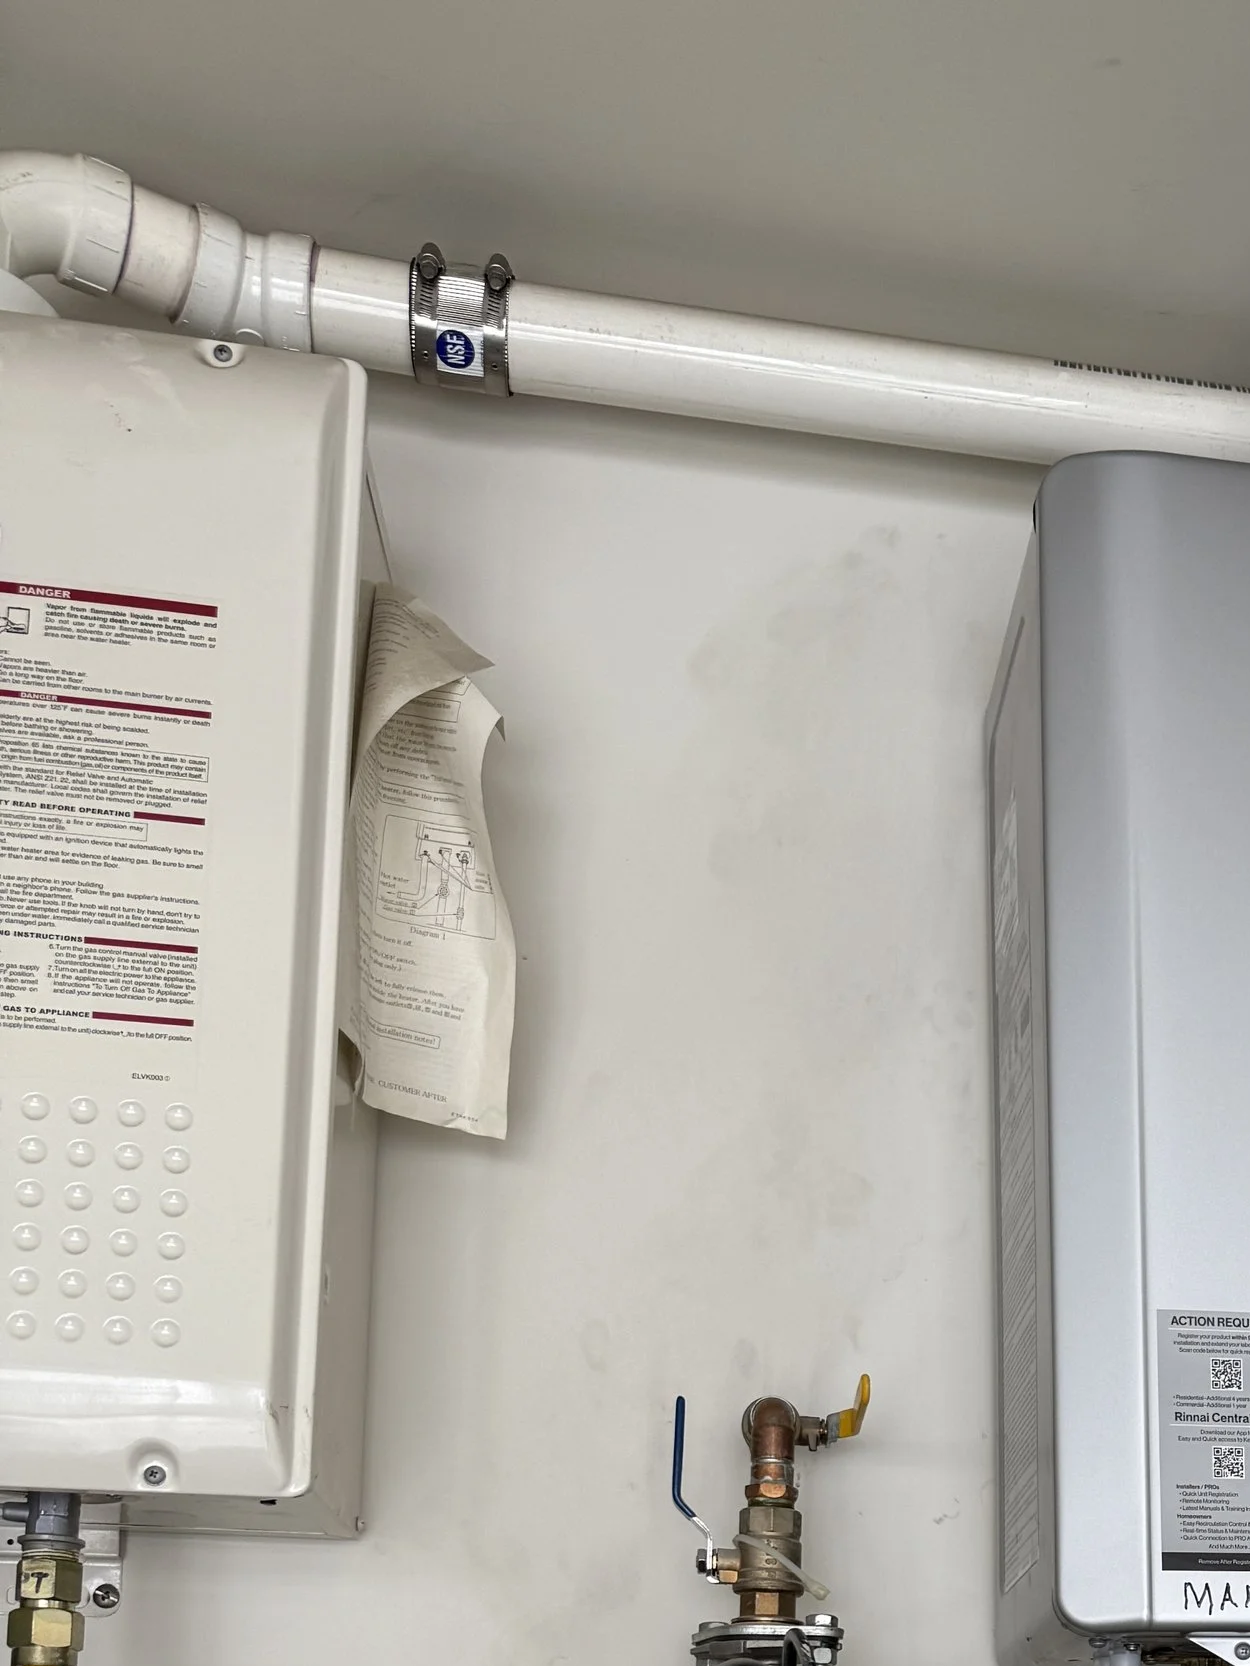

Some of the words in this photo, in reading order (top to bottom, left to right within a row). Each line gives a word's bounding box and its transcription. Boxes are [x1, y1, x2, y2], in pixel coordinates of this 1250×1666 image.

[446, 334, 466, 365] NSF
[19, 585, 71, 599] DANGER
[46, 603, 67, 613] Vapor
[69, 606, 86, 614] from
[89, 608, 126, 618] flammable
[129, 612, 154, 623] liquids
[156, 615, 169, 623] will
[172, 617, 200, 628] explode
[46, 610, 65, 618] catch
[65, 612, 78, 620] fire
[79, 614, 108, 624] causing
[108, 617, 129, 625] death
[113, 631, 147, 641] adhesives
[21, 678, 45, 687] carried
[46, 681, 62, 689] from
[62, 683, 80, 691] other
[111, 688, 123, 696] the
[123, 690, 141, 698] main
[141, 691, 163, 700] burner
[164, 694, 173, 702] by
[20, 692, 58, 702] DANGER
[54, 718, 80, 728] highest
[101, 723, 121, 733] being
[12, 799, 36, 808] READ
[39, 802, 76, 812] BEFORE
[78, 806, 131, 818] OPERATING
[30, 876, 52, 885] phone
[76, 880, 104, 889] building
[13, 931, 83, 943] INSTRUCTIONS
[410, 927, 439, 939] Diagram
[3, 1005, 21, 1013] GAS
[24, 1006, 36, 1014] TO
[38, 1007, 90, 1018] APPLIANCE
[377, 1027, 413, 1040] installation
[378, 1080, 421, 1096] CUSTOMER
[422, 1091, 447, 1103] AFTER
[1171, 1316, 1215, 1327] ACTION
[1175, 1412, 1209, 1422] Rinnai
